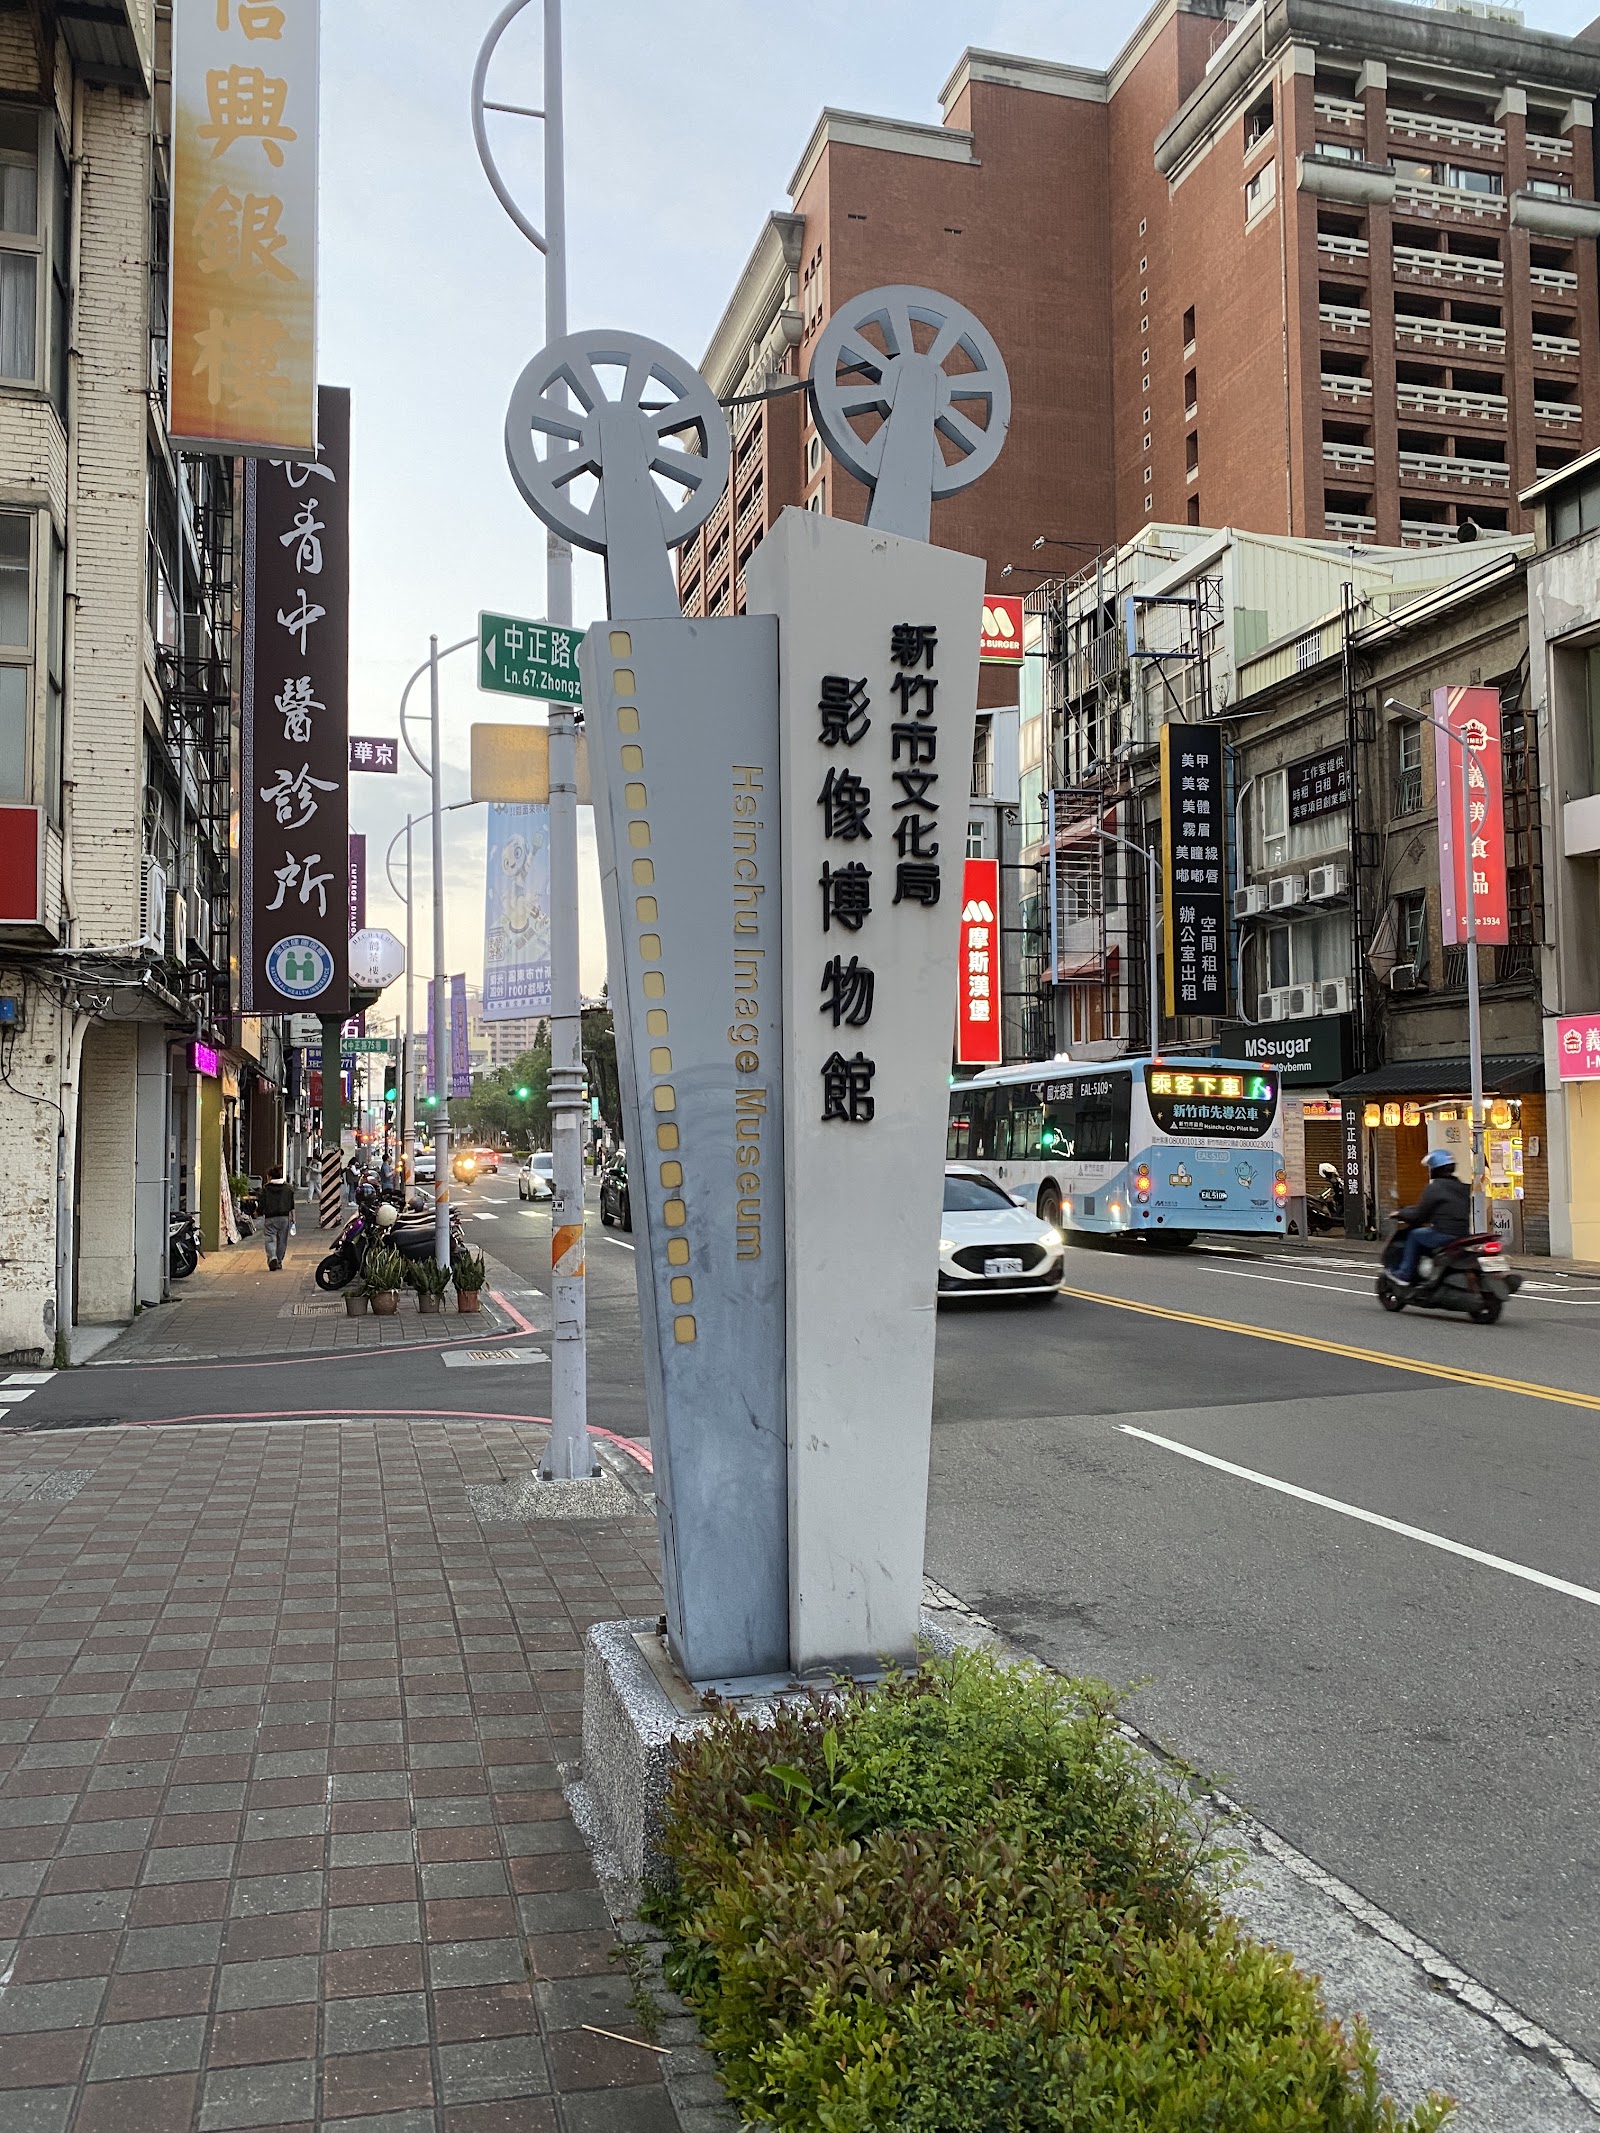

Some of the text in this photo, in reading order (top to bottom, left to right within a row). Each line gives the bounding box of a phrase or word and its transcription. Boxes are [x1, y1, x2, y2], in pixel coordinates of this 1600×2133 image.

[986, 640, 1020, 650] BURGER
[504, 665, 521, 685] Ln.
[540, 671, 581, 699] Zhongz
[890, 622, 941, 906] 新竹市文化局
[1181, 753, 1210, 769] 美甲
[1302, 755, 1345, 782] 工作室提供
[1182, 776, 1210, 791] 美容
[1292, 786, 1309, 801] 時租
[1315, 777, 1331, 794] 日租
[1182, 799, 1211, 814] 美體
[1183, 822, 1211, 838] 霧眉
[1468, 765, 1491, 896] 義美食品
[1175, 845, 1219, 861] 美瞳線
[1176, 868, 1219, 884] 嘟嘟唇
[816, 674, 876, 1123] 影像博物館
[1462, 917, 1500, 926] Sce 1934
[1179, 905, 1197, 1002] 辦公室出租
[1200, 916, 1218, 992] 空間租借
[968, 927, 990, 1022] 摩斯漢堡
[727, 765, 767, 1262] Hsinchu Image Museum
[1245, 1038, 1311, 1059] MSsugar
[1278, 1062, 1312, 1073] 9vbemm
[1047, 1083, 1073, 1101] 國光客運
[1081, 1082, 1109, 1096] EAL-5109
[1151, 1074, 1241, 1097] 乘客下車
[1173, 1104, 1259, 1120] 新竹市先導公車
[1226, 1124, 1236, 1132] City
[1197, 1151, 1228, 1160] EAL-5109
[1346, 1109, 1359, 1195] 中正路88號
